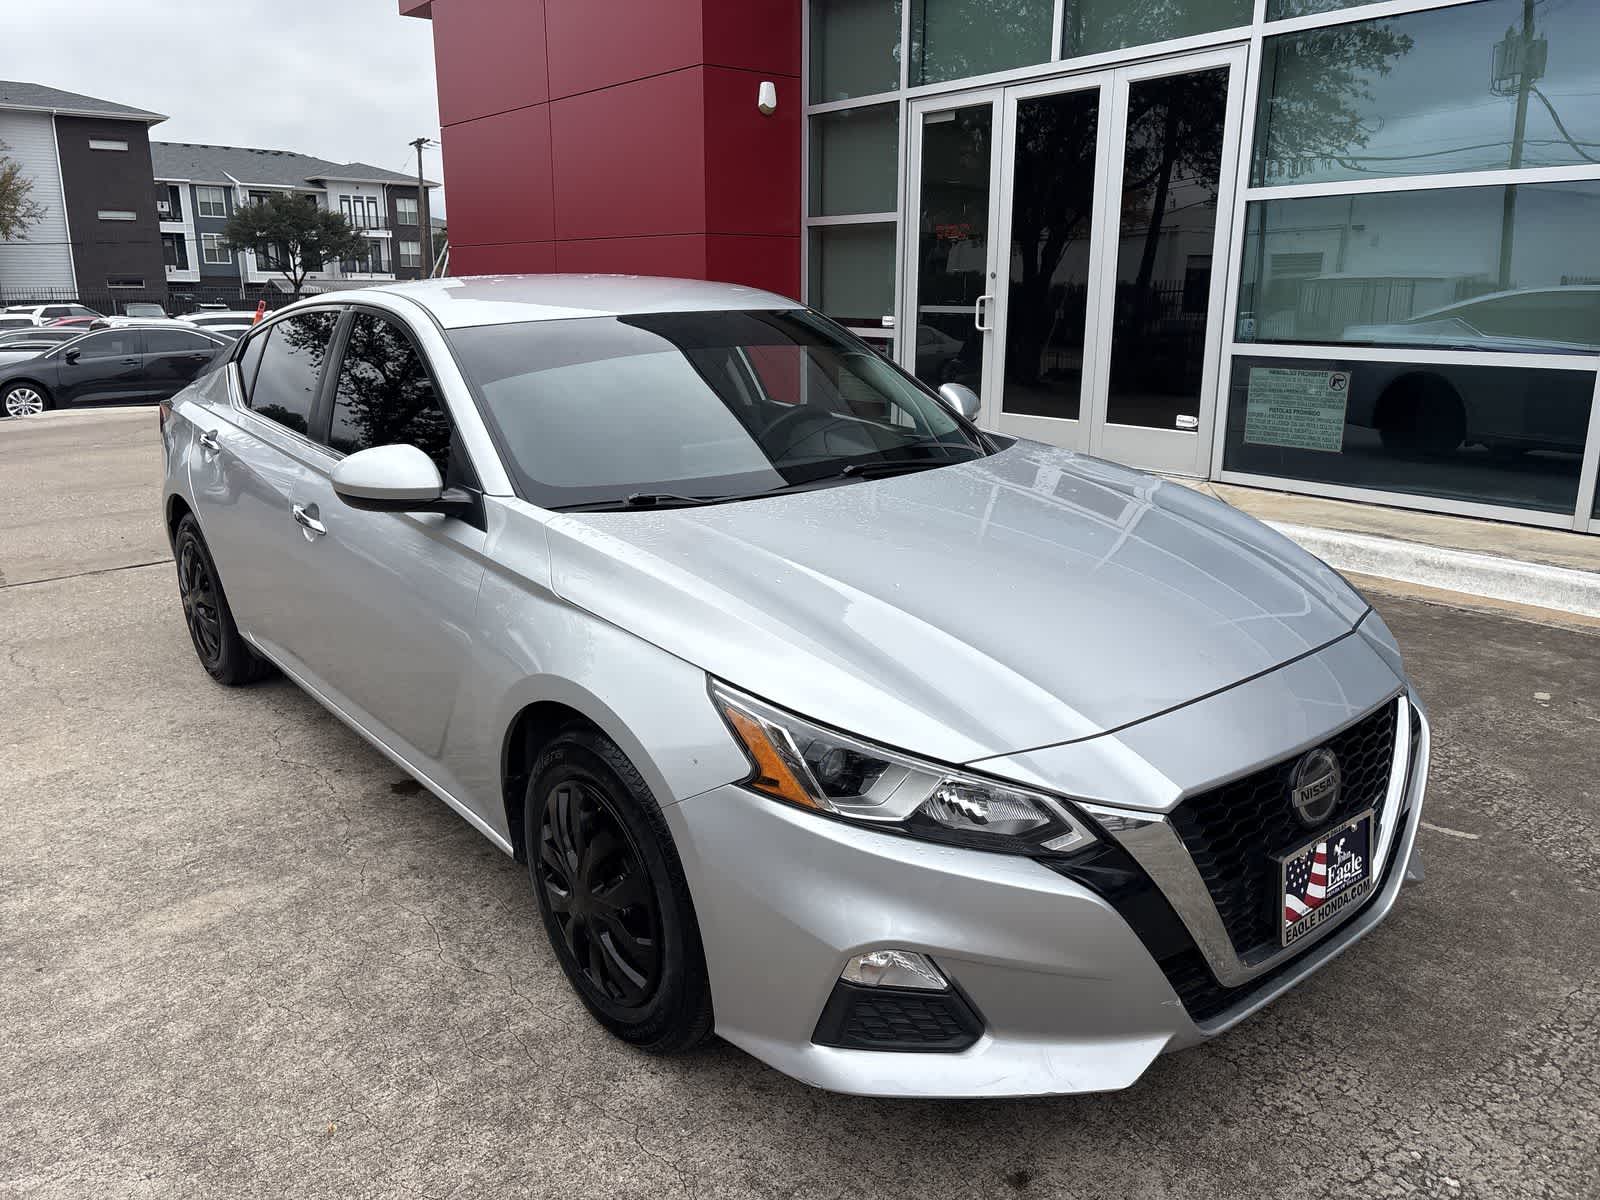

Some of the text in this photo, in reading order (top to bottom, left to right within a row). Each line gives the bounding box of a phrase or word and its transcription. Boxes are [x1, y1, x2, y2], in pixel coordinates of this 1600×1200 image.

[1301, 773, 1337, 801] NISSAN
[1328, 853, 1363, 887] Eagle
[1286, 913, 1316, 943] EAGLE
[1317, 878, 1371, 921] HONDA.COM
